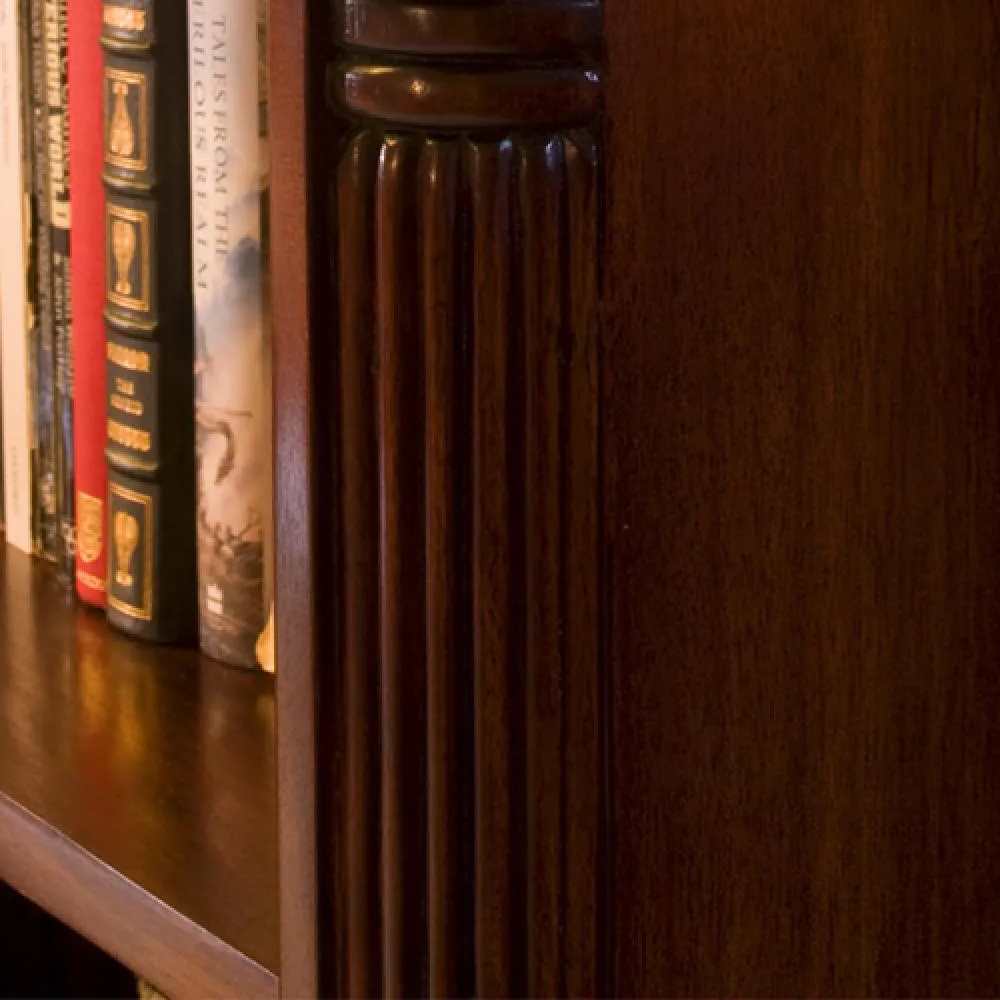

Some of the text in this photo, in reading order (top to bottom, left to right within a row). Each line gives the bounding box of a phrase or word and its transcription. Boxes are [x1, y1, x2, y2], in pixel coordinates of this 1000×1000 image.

[49, 112, 71, 229] WORLD
[210, 14, 230, 257] TALES FROM THE
[195, 164, 209, 291] REALM
